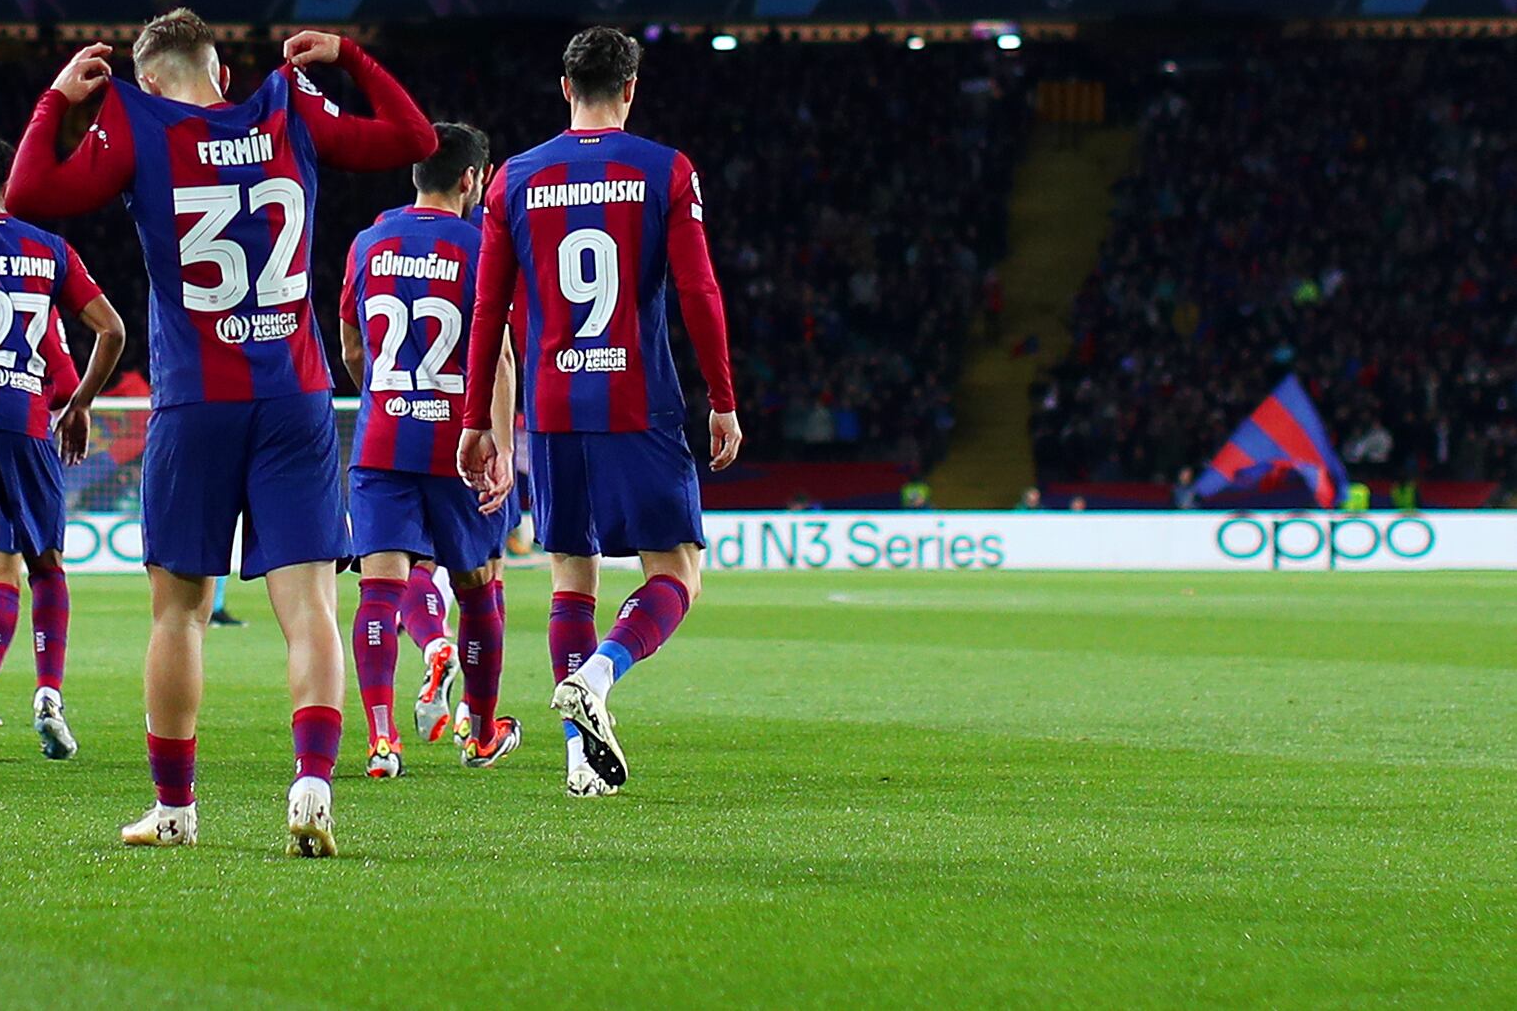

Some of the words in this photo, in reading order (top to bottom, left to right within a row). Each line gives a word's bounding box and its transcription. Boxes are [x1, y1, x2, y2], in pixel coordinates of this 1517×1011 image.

[198, 127, 273, 166] FERMÍN
[526, 181, 645, 209] LEWANDOWSKI
[173, 177, 308, 312] 32
[371, 250, 460, 282] GÜNDOĞAN
[558, 228, 618, 337] 9
[364, 294, 464, 393] 22
[585, 348, 627, 358] UNHCR
[585, 357, 627, 367] ACNUR
[760, 522, 832, 567] N3
[847, 520, 1006, 568] Series
[1217, 518, 1436, 570] oppo
